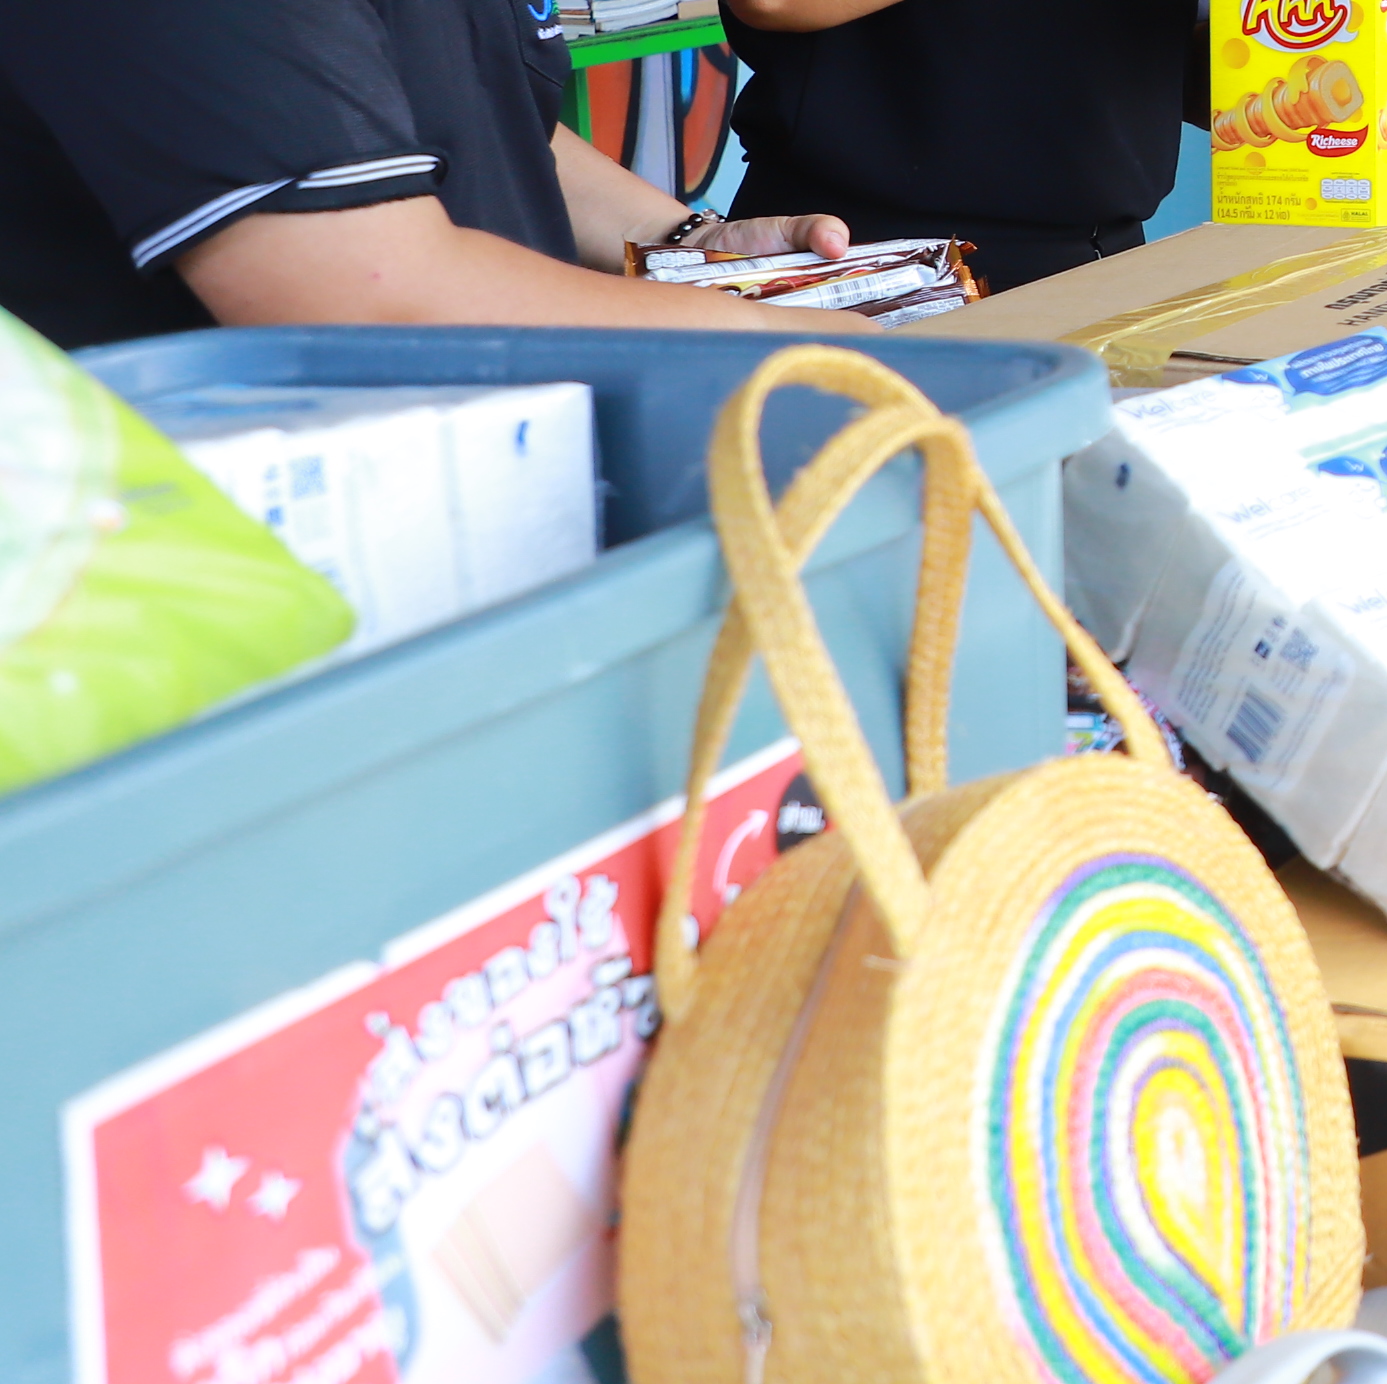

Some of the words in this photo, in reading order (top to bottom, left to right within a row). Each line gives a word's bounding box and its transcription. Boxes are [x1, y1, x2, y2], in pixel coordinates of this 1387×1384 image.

[1310, 134, 1358, 150] Richeese
[1266, 195, 1283, 206] 174
[1284, 192, 1302, 206] กรัม
